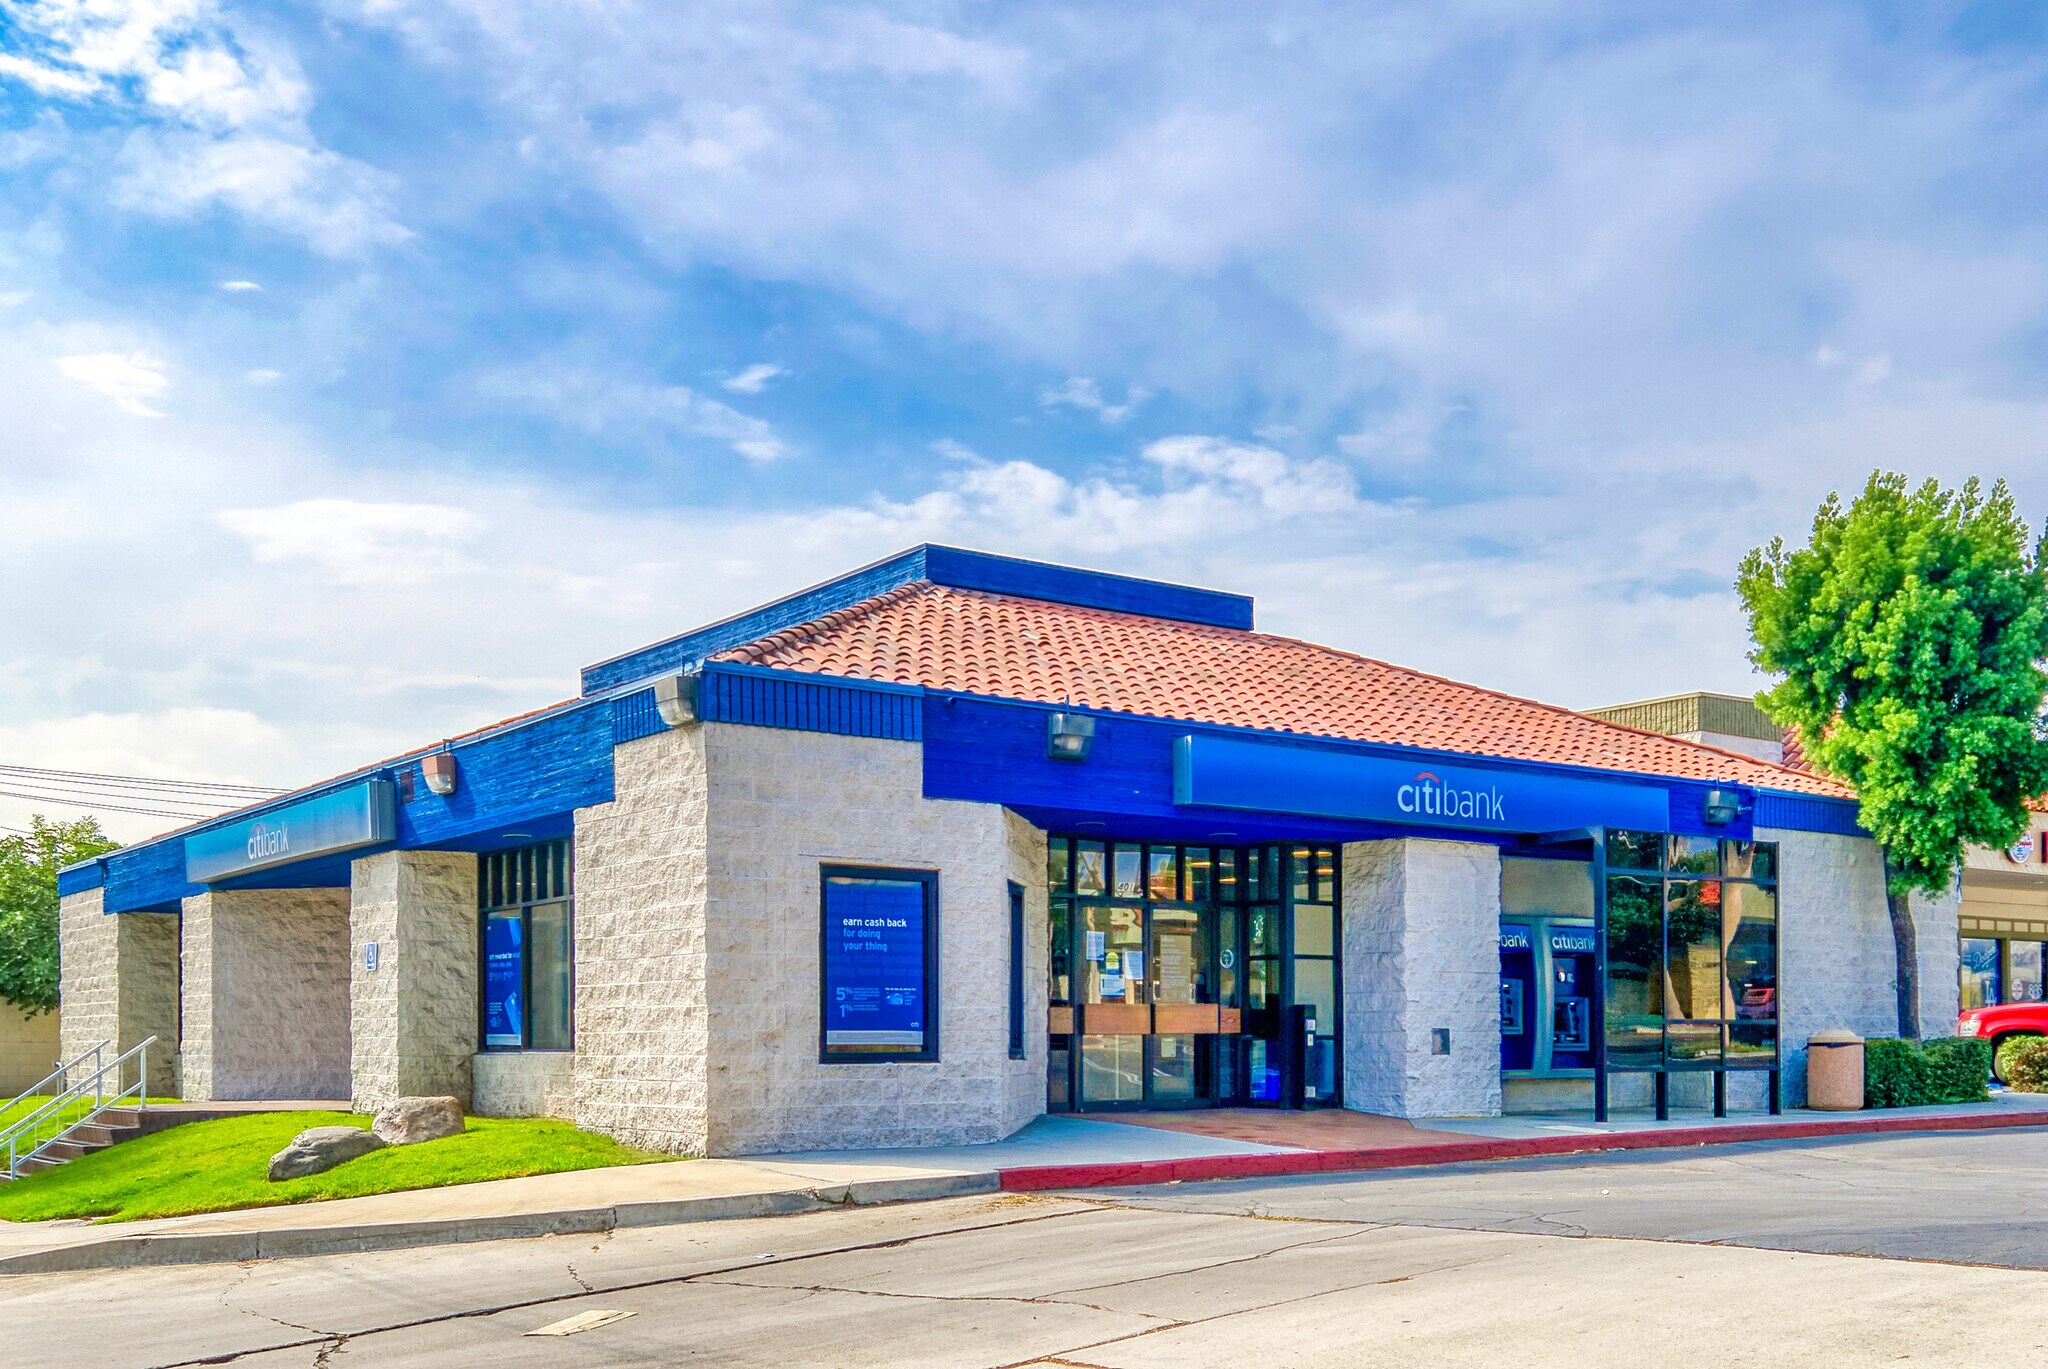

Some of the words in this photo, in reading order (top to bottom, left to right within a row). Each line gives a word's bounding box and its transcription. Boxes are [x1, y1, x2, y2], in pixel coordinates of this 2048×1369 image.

[1397, 777, 1505, 821] citibank
[247, 821, 290, 860] citibank
[842, 918, 863, 927] earn
[864, 918, 885, 927] cash
[886, 918, 907, 928] back
[843, 927, 856, 937] for
[857, 928, 881, 940] doing
[843, 942, 863, 952] your
[865, 941, 888, 953] thing
[836, 987, 853, 1001] 5%
